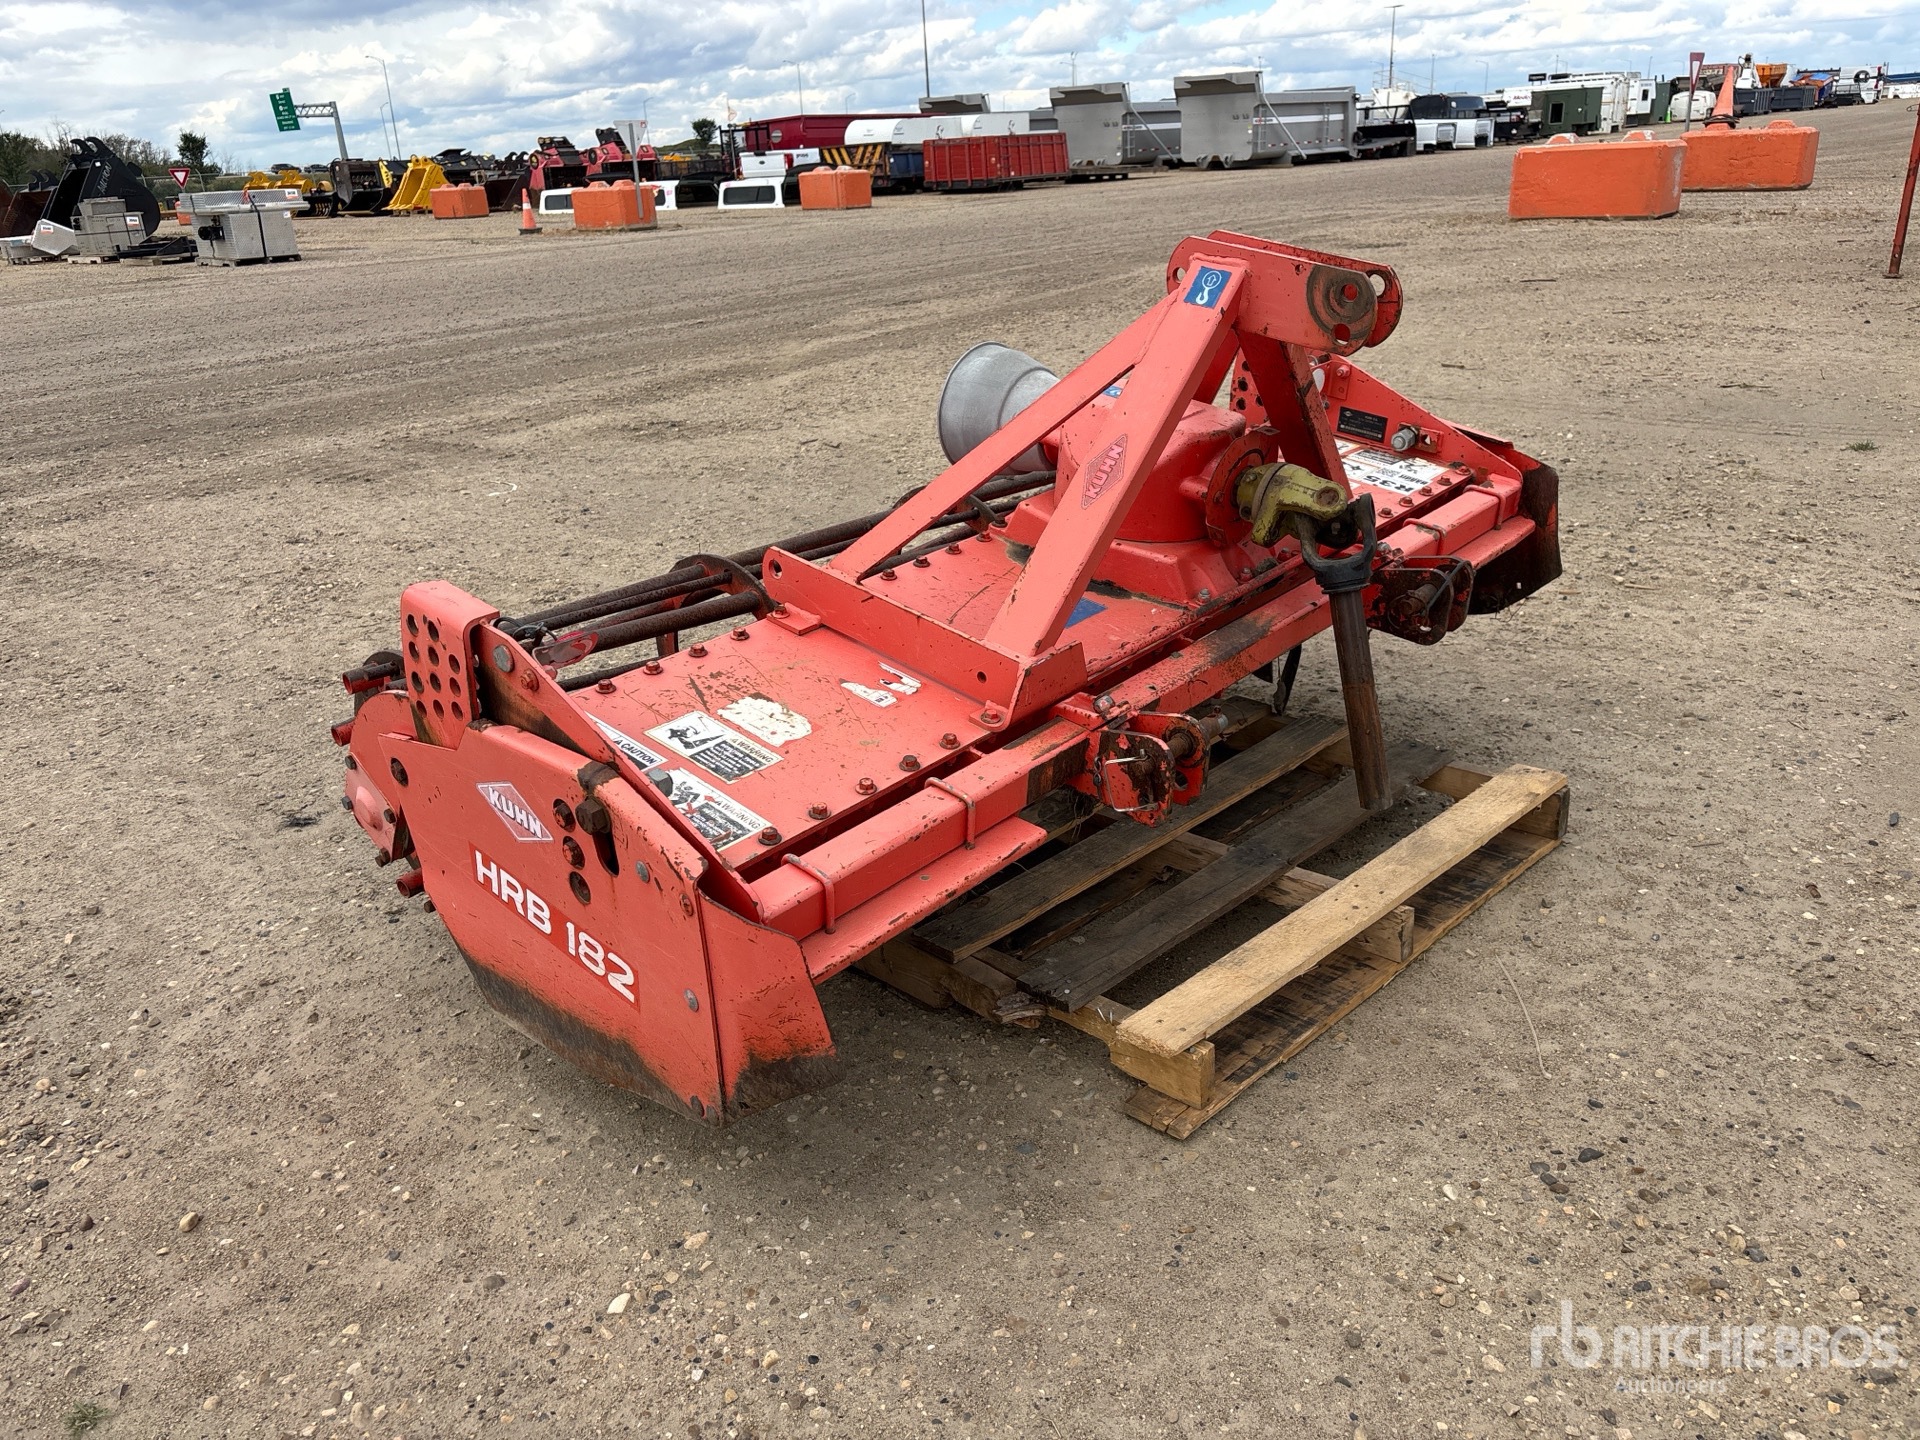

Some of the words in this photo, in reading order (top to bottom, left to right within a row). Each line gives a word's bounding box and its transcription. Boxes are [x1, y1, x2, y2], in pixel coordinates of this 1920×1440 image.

[1086, 443, 1126, 500] KUHN
[620, 743, 657, 764] CAUTION
[487, 785, 544, 840] KUHN
[474, 850, 552, 936] HRB
[565, 921, 636, 1005] 182
